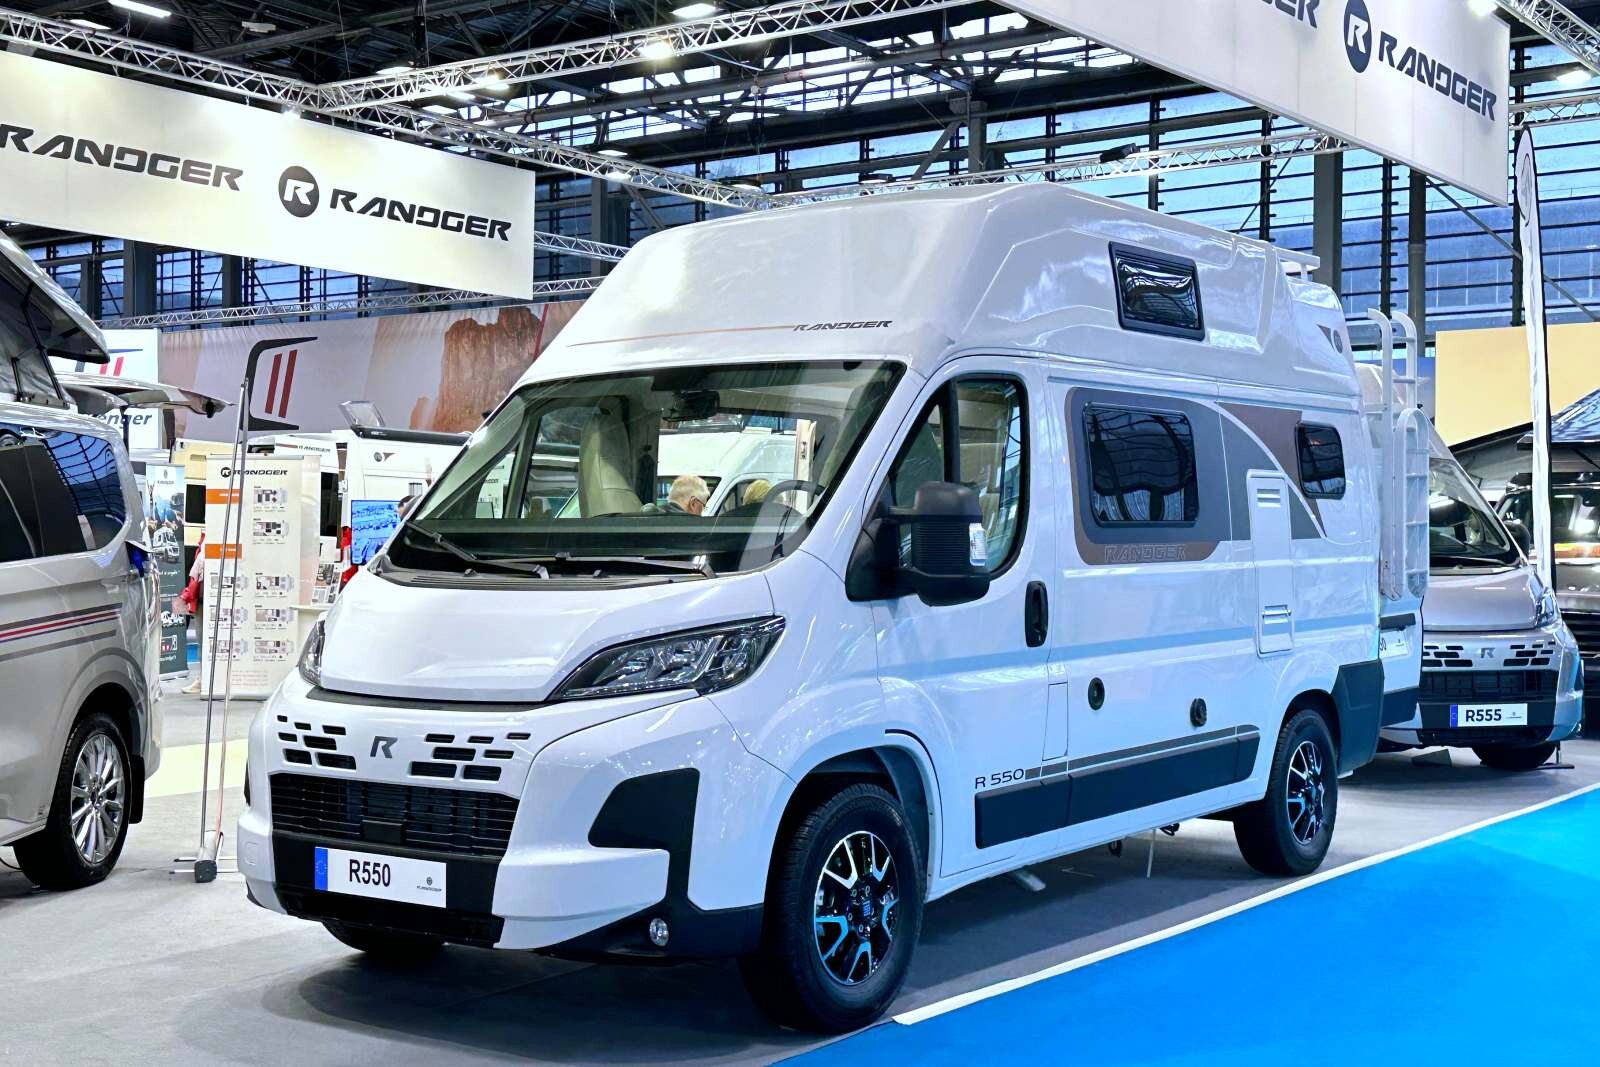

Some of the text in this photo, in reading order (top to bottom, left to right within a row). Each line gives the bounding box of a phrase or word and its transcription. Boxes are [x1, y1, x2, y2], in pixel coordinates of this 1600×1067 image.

[1378, 30, 1497, 122] RANDGER
[0, 123, 244, 192] RANDGER
[329, 188, 512, 242] RANDGER
[793, 320, 893, 332] RANDGER
[1465, 708, 1502, 722] R555
[975, 768, 1025, 789] R 550
[349, 858, 391, 887] R550
